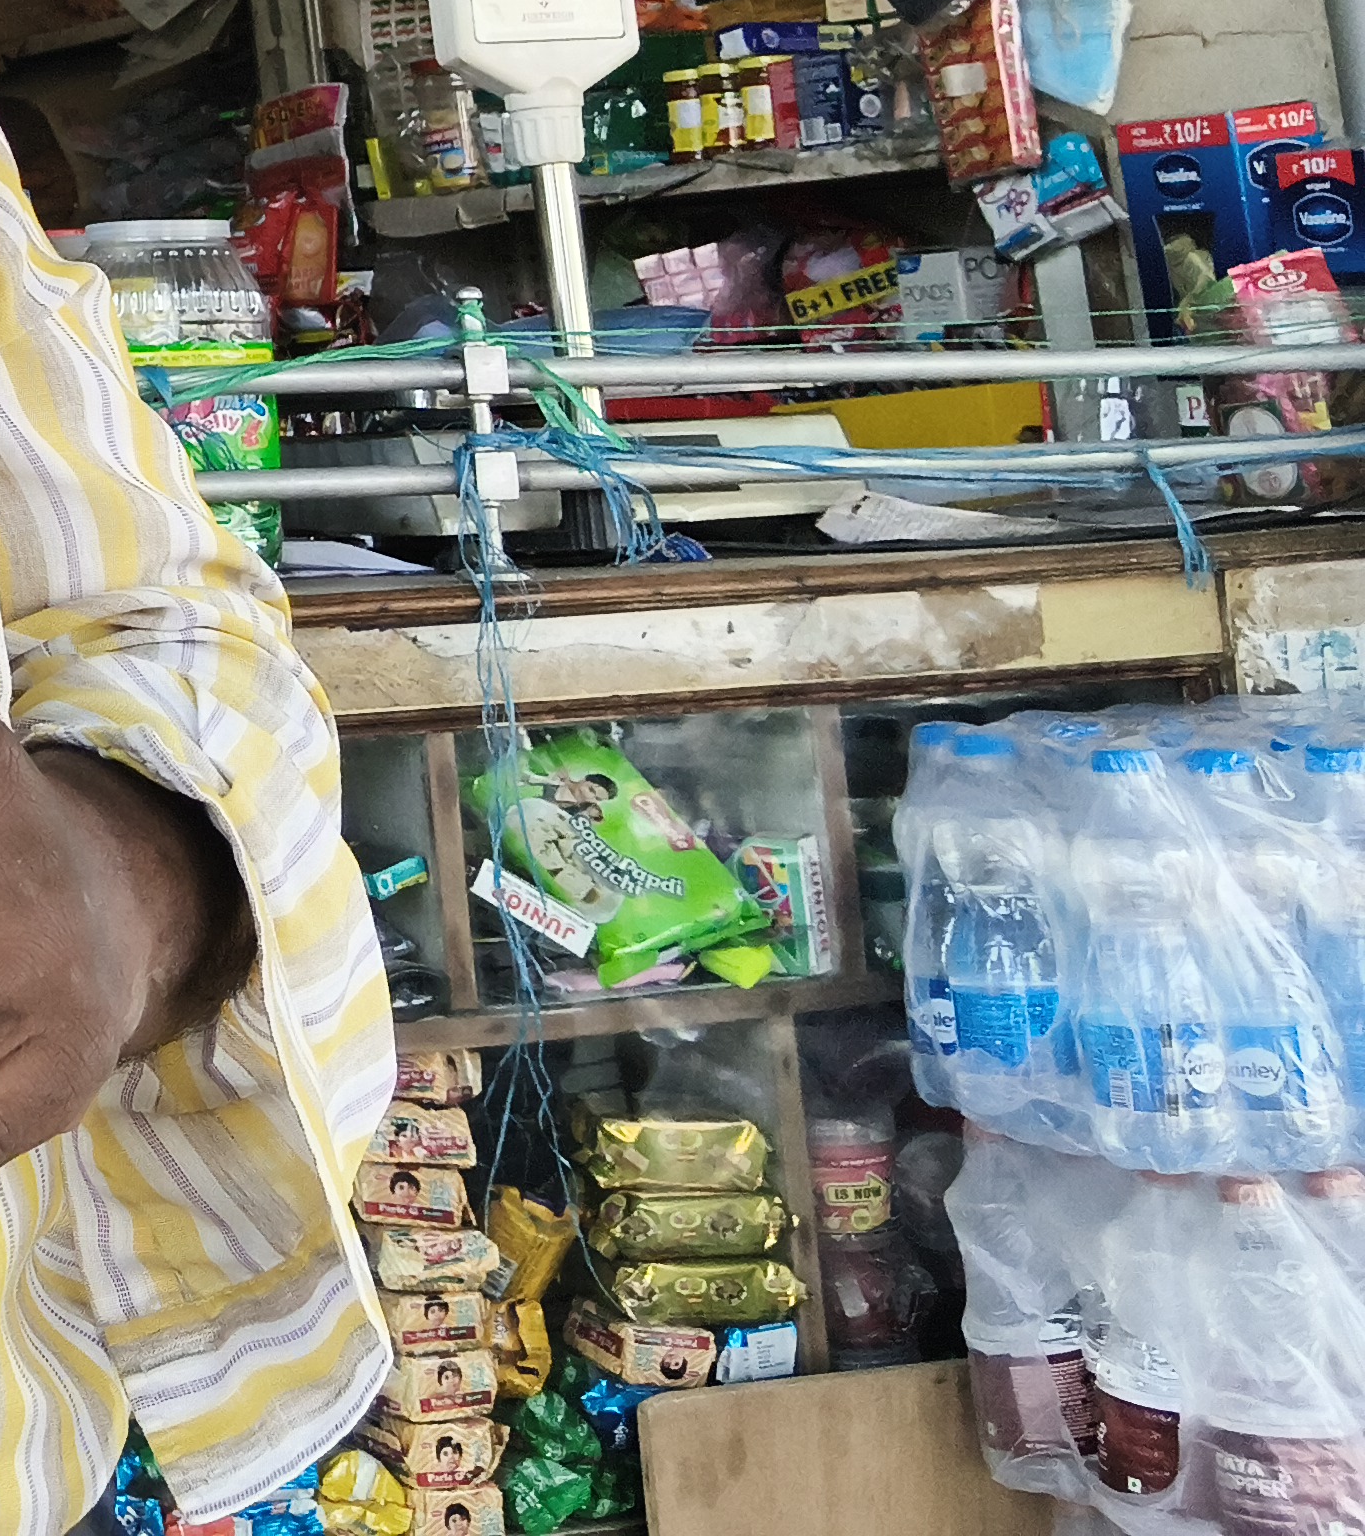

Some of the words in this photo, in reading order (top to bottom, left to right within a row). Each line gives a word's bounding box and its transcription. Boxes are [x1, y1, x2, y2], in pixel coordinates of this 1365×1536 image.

[792, 288, 838, 318] 6+1
[840, 267, 900, 300] FREE
[569, 814, 621, 867] Soan
[619, 856, 686, 898] Papdi
[573, 837, 645, 896] Elaichi
